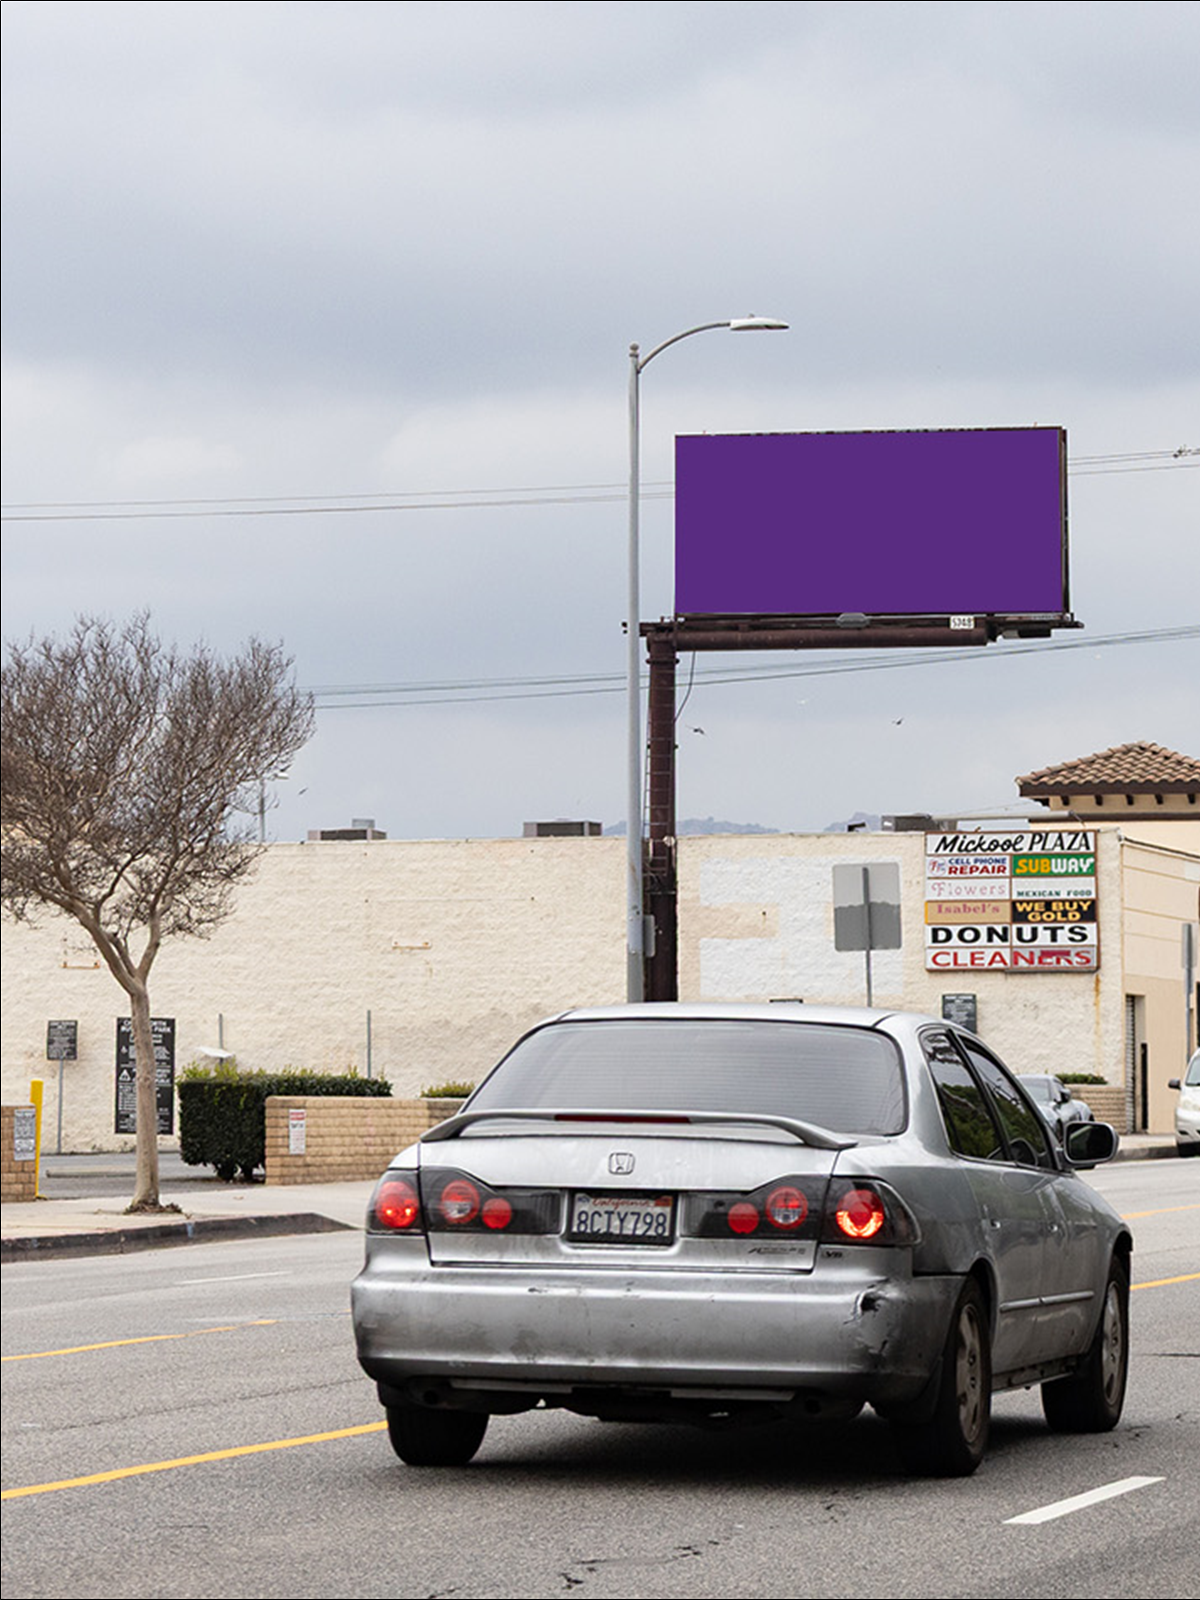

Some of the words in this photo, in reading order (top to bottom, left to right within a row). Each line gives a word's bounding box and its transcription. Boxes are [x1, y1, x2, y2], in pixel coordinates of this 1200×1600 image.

[935, 834, 1024, 853] Mickool
[1029, 832, 1090, 851] PLAZA
[948, 857, 971, 865] CELL
[973, 857, 1007, 865] PHONE
[1015, 857, 1095, 874] SUBWAY
[948, 865, 1007, 875] REPAIR
[931, 881, 1006, 897] Flowers
[1016, 889, 1061, 897] MEXICAN
[1067, 889, 1092, 897] FOOD
[937, 903, 1000, 914] Isabel's
[1015, 901, 1045, 912] WE
[1052, 901, 1091, 911] BUY
[1027, 912, 1081, 921] GOLD
[931, 926, 1088, 944] DONUTS
